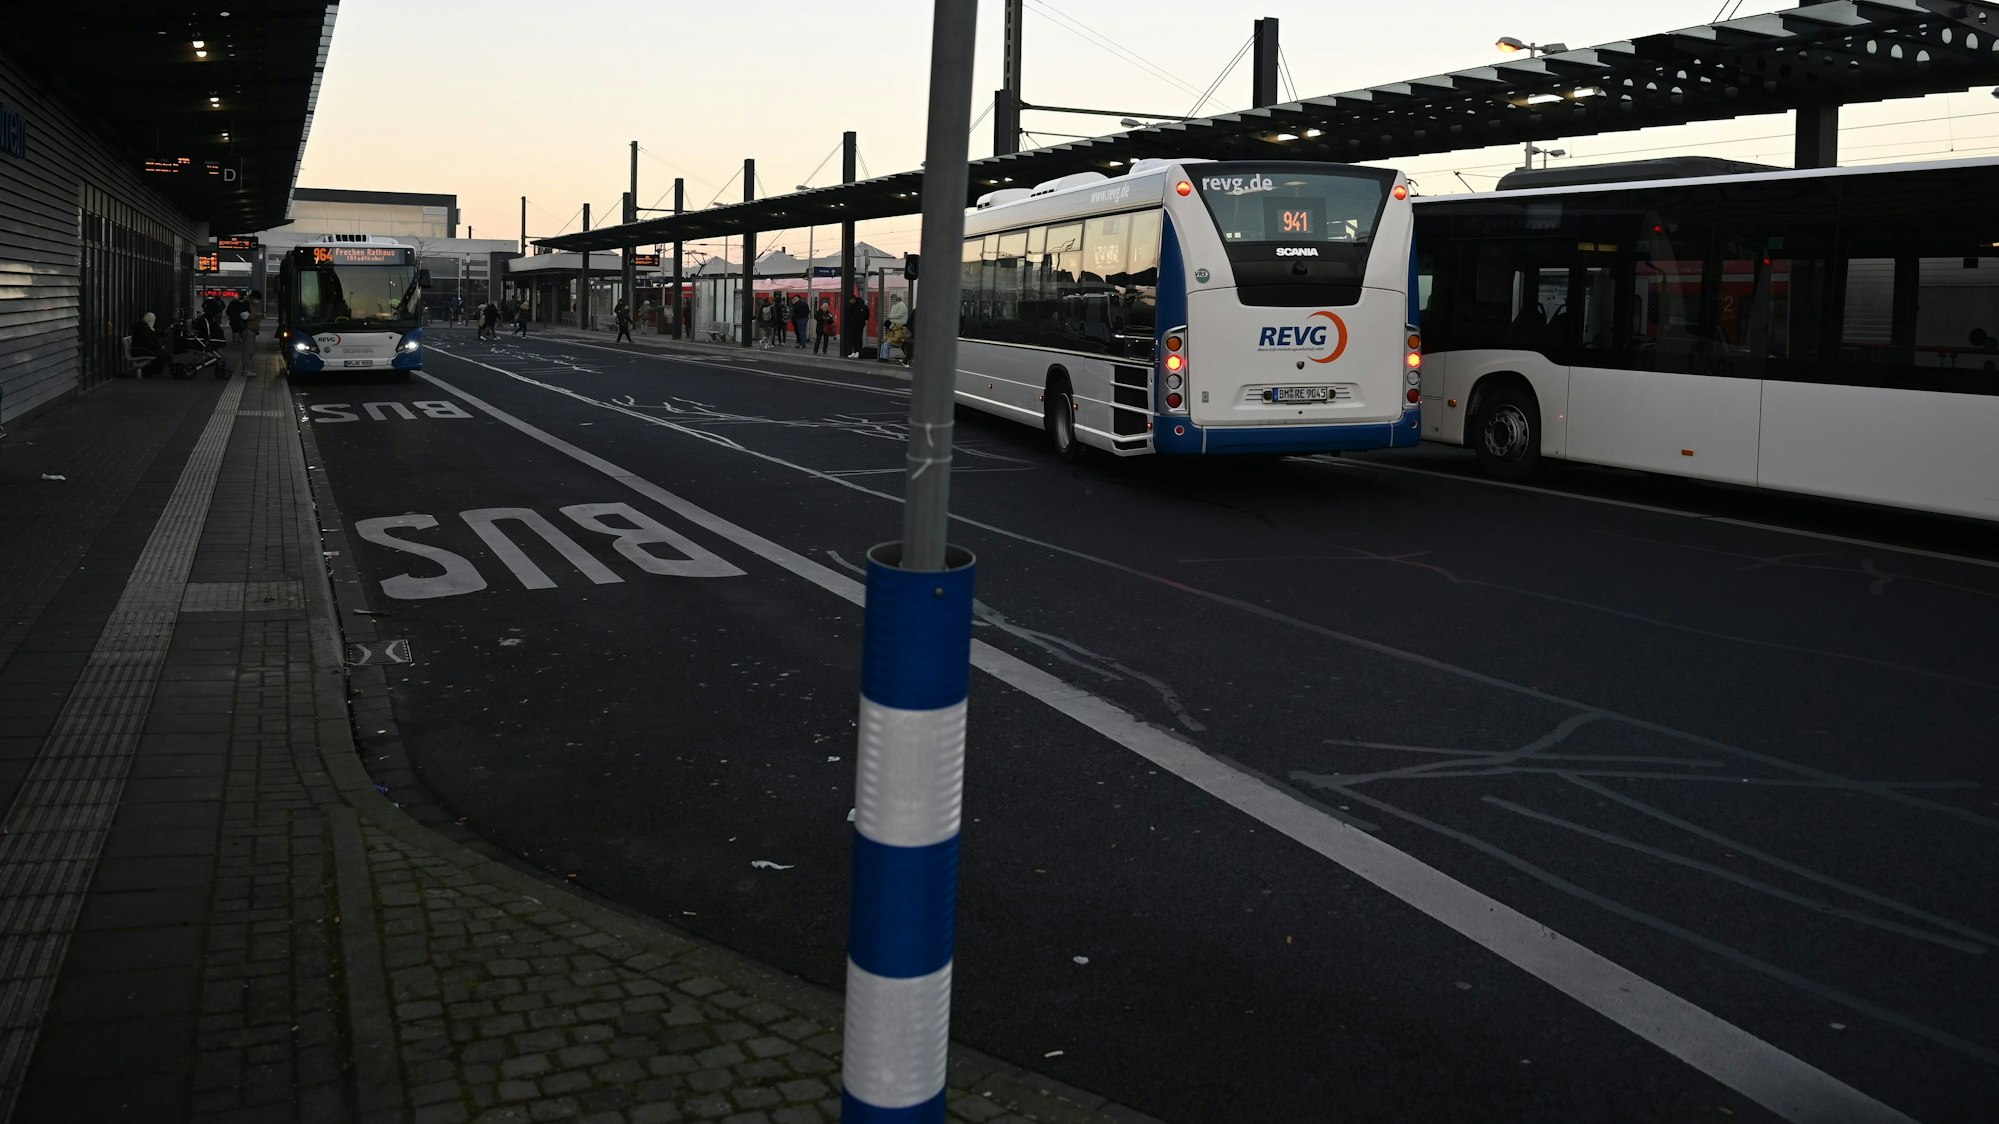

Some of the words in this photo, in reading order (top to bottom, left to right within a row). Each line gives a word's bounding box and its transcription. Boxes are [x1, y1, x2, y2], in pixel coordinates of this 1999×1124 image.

[224, 169, 236, 181] D
[1090, 182, 1130, 203] www.revg.de
[1202, 174, 1273, 195] revg.de
[1283, 211, 1308, 232] 941
[313, 248, 333, 262] 964
[336, 248, 364, 256] Frechen
[367, 248, 395, 256] Rathaus
[1276, 247, 1319, 256] SCANIA
[1724, 295, 1734, 312] 2
[1259, 326, 1327, 346] REVG
[1280, 389, 1290, 399] BM
[1295, 389, 1305, 398] RE
[1306, 388, 1326, 398] 9045
[310, 400, 474, 423] BUS
[354, 502, 749, 600] BUS
